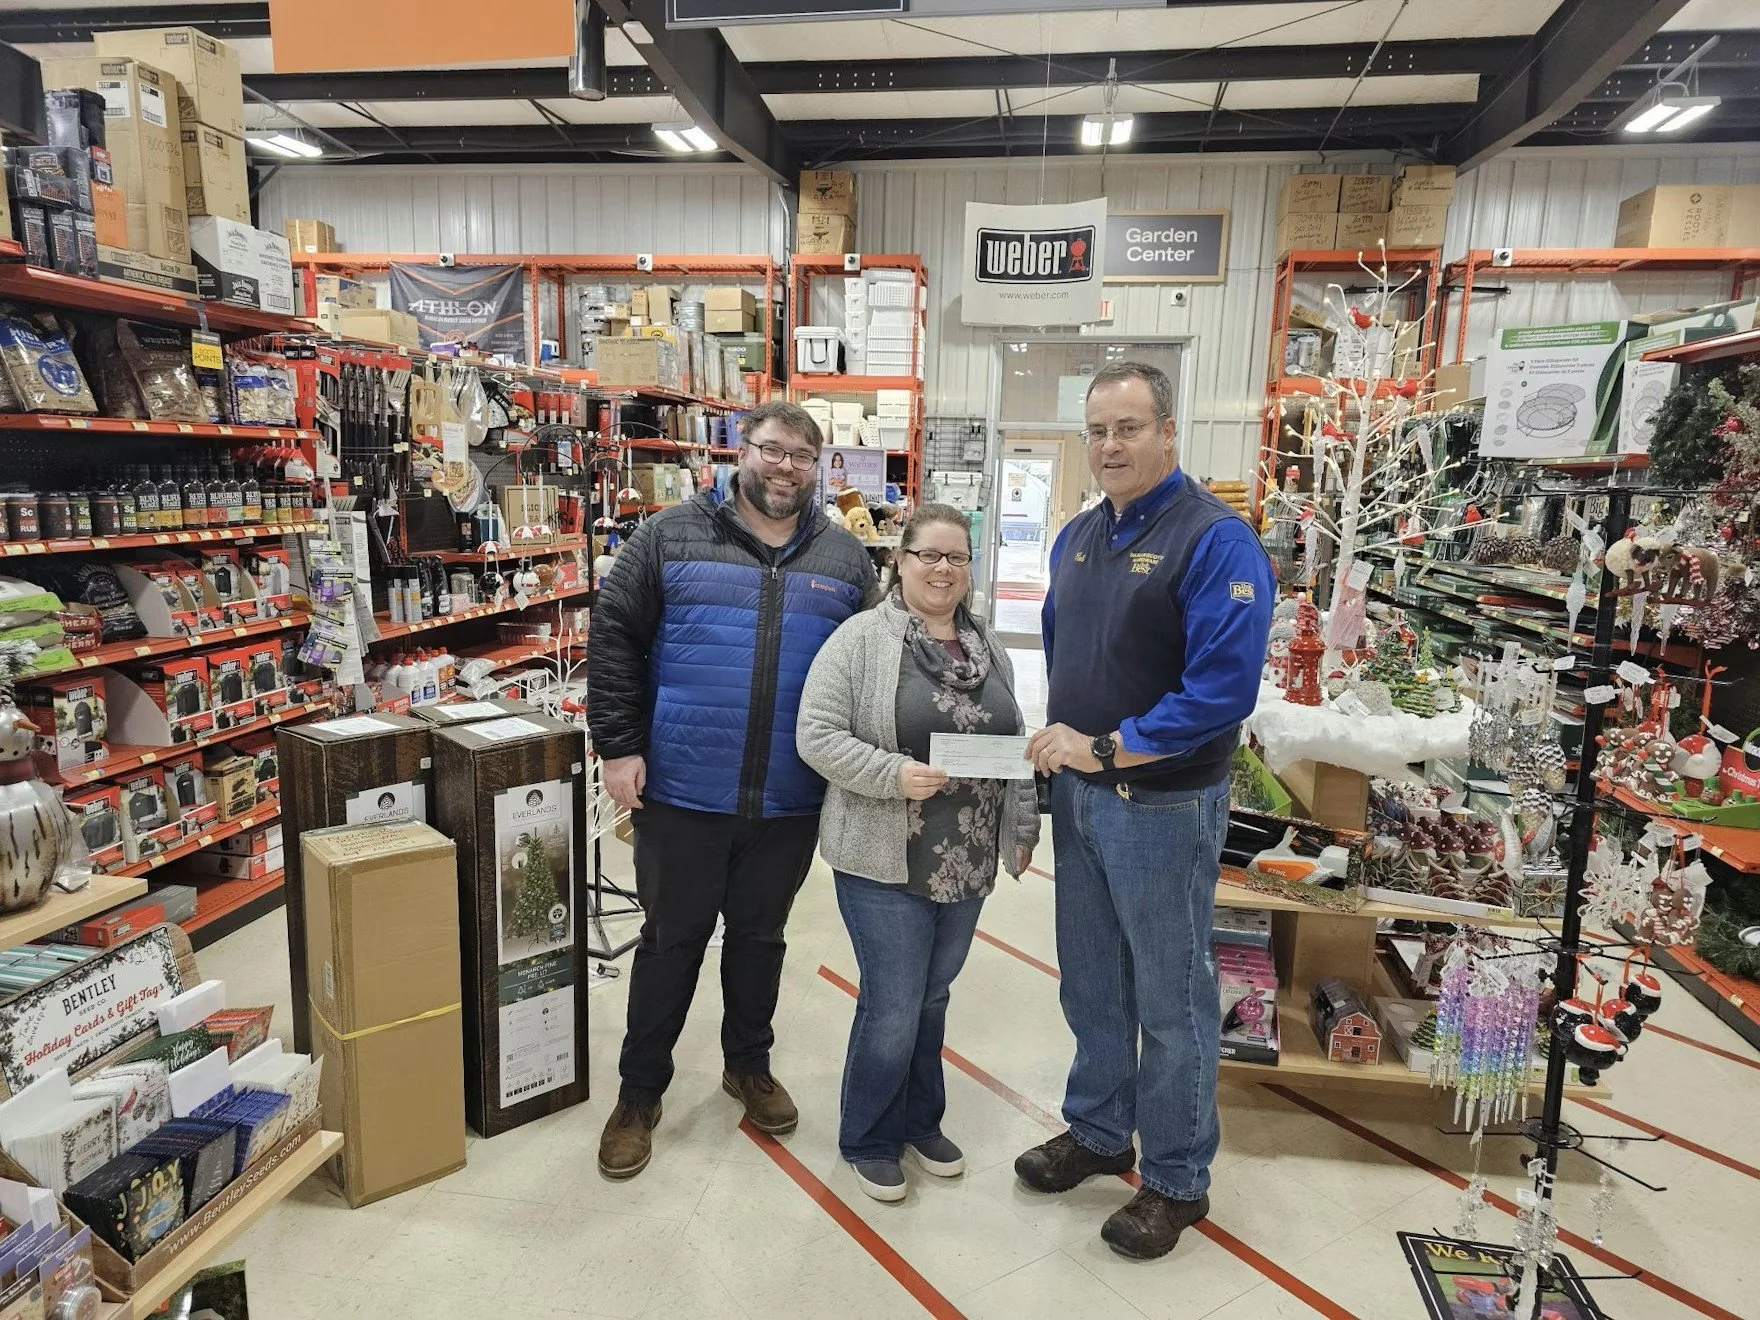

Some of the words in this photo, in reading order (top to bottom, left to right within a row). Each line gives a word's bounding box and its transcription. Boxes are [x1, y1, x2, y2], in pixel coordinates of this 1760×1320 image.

[1126, 227, 1198, 244] Garden
[986, 232, 1068, 276] weber
[1127, 246, 1195, 263] Center
[1000, 290, 1070, 300] www.weber.com
[194, 353, 222, 364] POINTS
[20, 507, 33, 517] Sc
[512, 804, 557, 820] EVERLANDS
[1266, 867, 1288, 877] STIHL
[517, 965, 544, 977] MONARCH
[62, 973, 116, 1016] BENTLEY
[79, 1004, 95, 1017] SEED
[24, 1033, 72, 1066] Holiday
[74, 1014, 106, 1037] Cards
[107, 1008, 115, 1019] &
[116, 994, 138, 1017] Gift
[139, 982, 165, 1002] Tags
[136, 1157, 180, 1213] JOY
[168, 1134, 301, 1255] www.BentleySeeds.com
[1423, 1241, 1470, 1260] We
